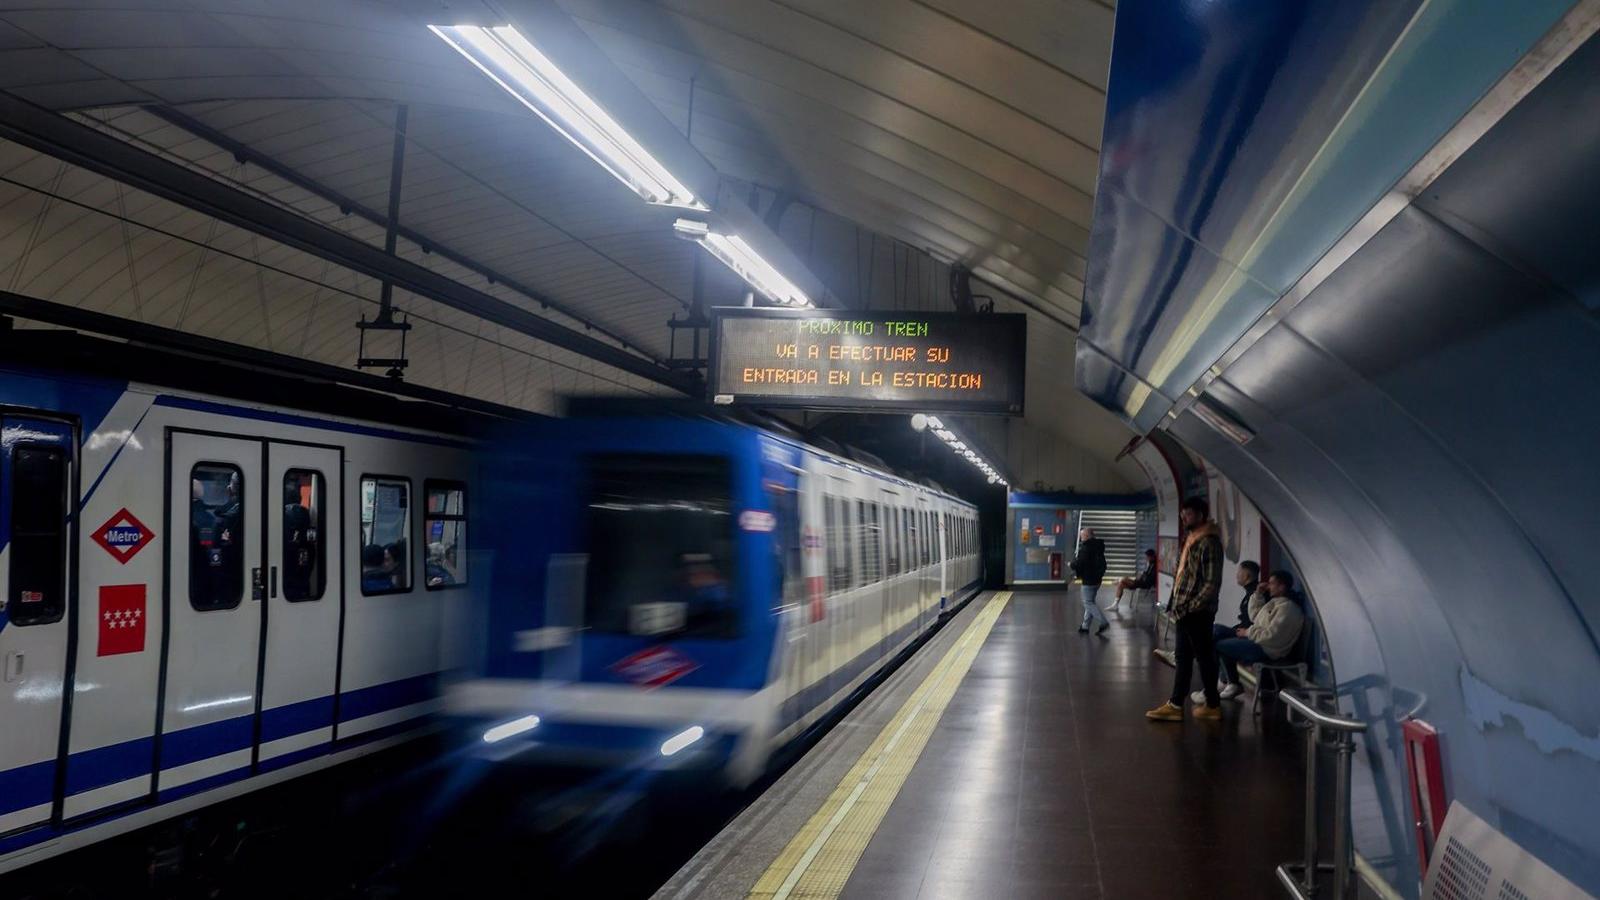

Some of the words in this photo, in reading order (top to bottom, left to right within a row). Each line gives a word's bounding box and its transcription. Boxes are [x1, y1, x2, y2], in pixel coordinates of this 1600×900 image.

[798, 320, 873, 336] PROXIMO
[885, 321, 928, 337] TREN
[777, 344, 799, 360] VA
[808, 345, 819, 359] A
[829, 345, 916, 361] EFECTUAR
[927, 347, 949, 363] SU
[743, 367, 818, 384] ENTRADA
[828, 370, 850, 385] EN
[861, 371, 883, 386] LA
[892, 371, 982, 389] ESTACION
[108, 529, 138, 543] Metro
